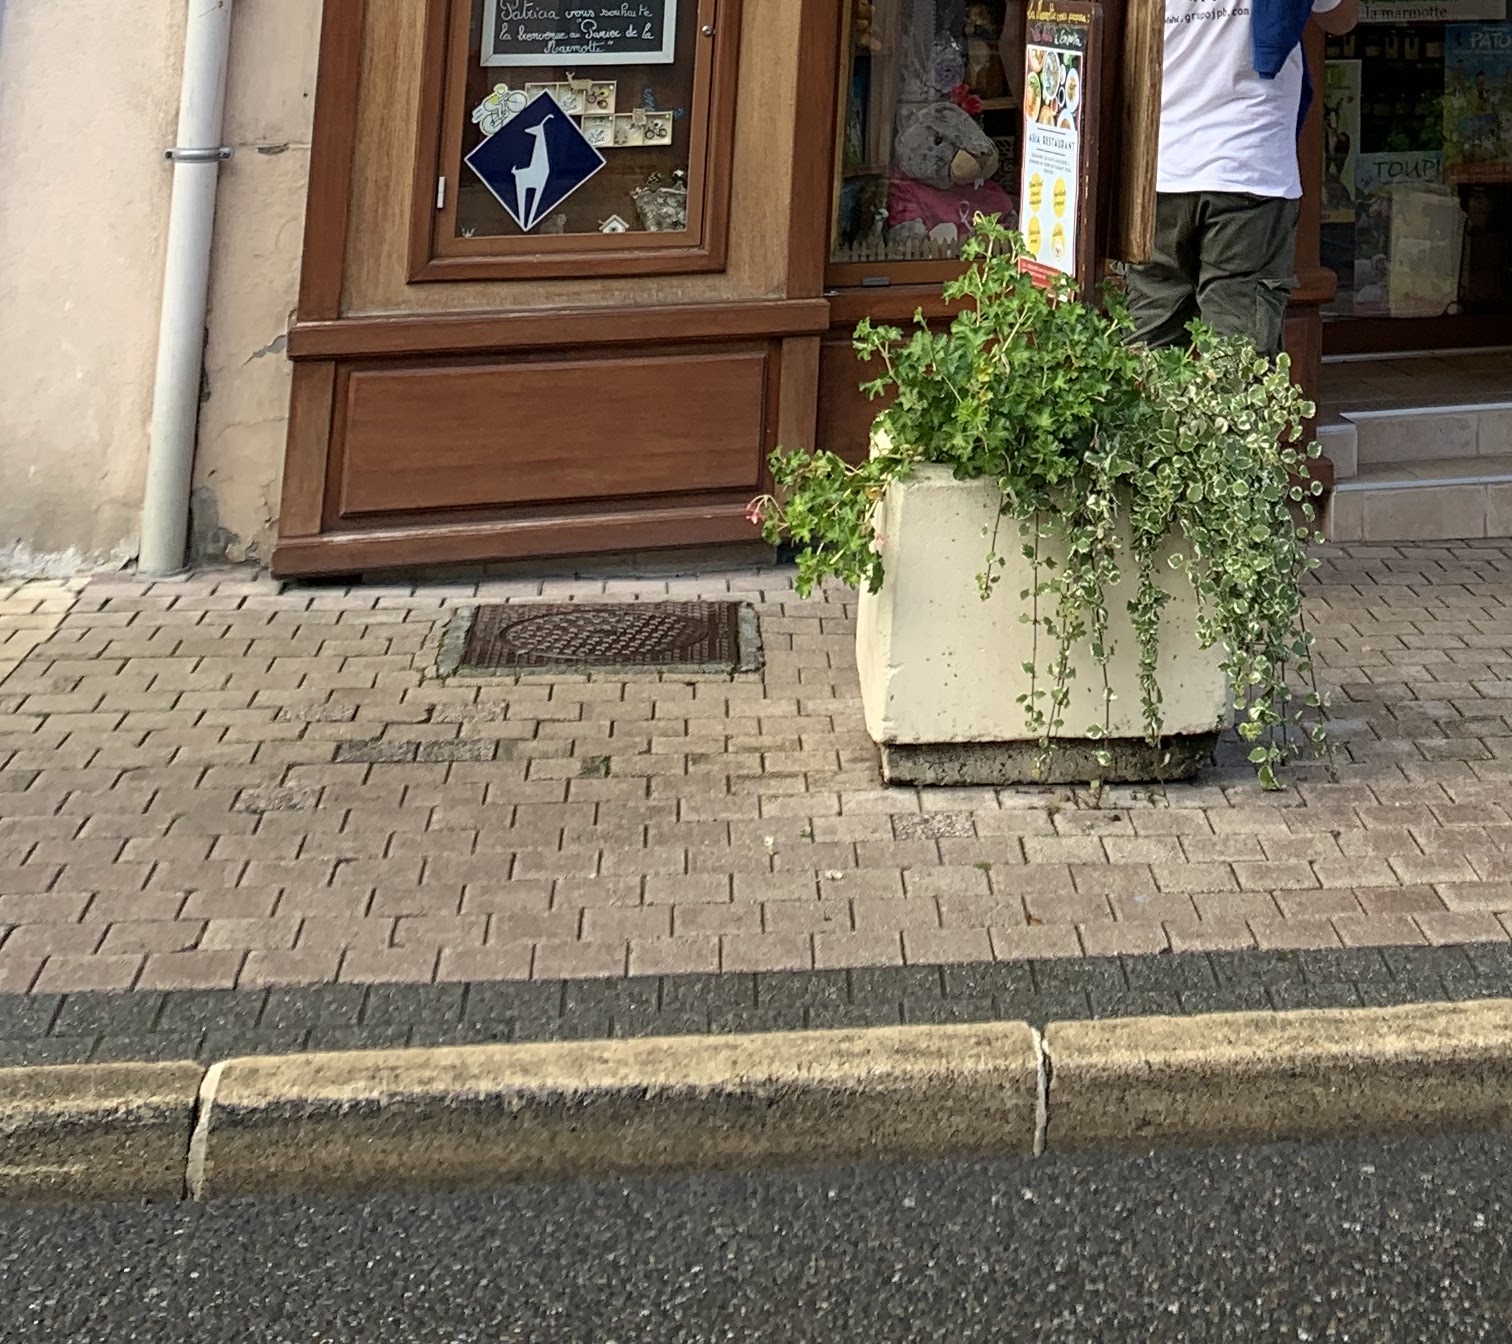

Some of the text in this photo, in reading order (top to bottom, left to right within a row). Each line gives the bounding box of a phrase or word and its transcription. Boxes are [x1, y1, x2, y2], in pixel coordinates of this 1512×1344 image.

[1365, 5, 1448, 20] la marmotte
[1042, 135, 1076, 151] RESTAURANT
